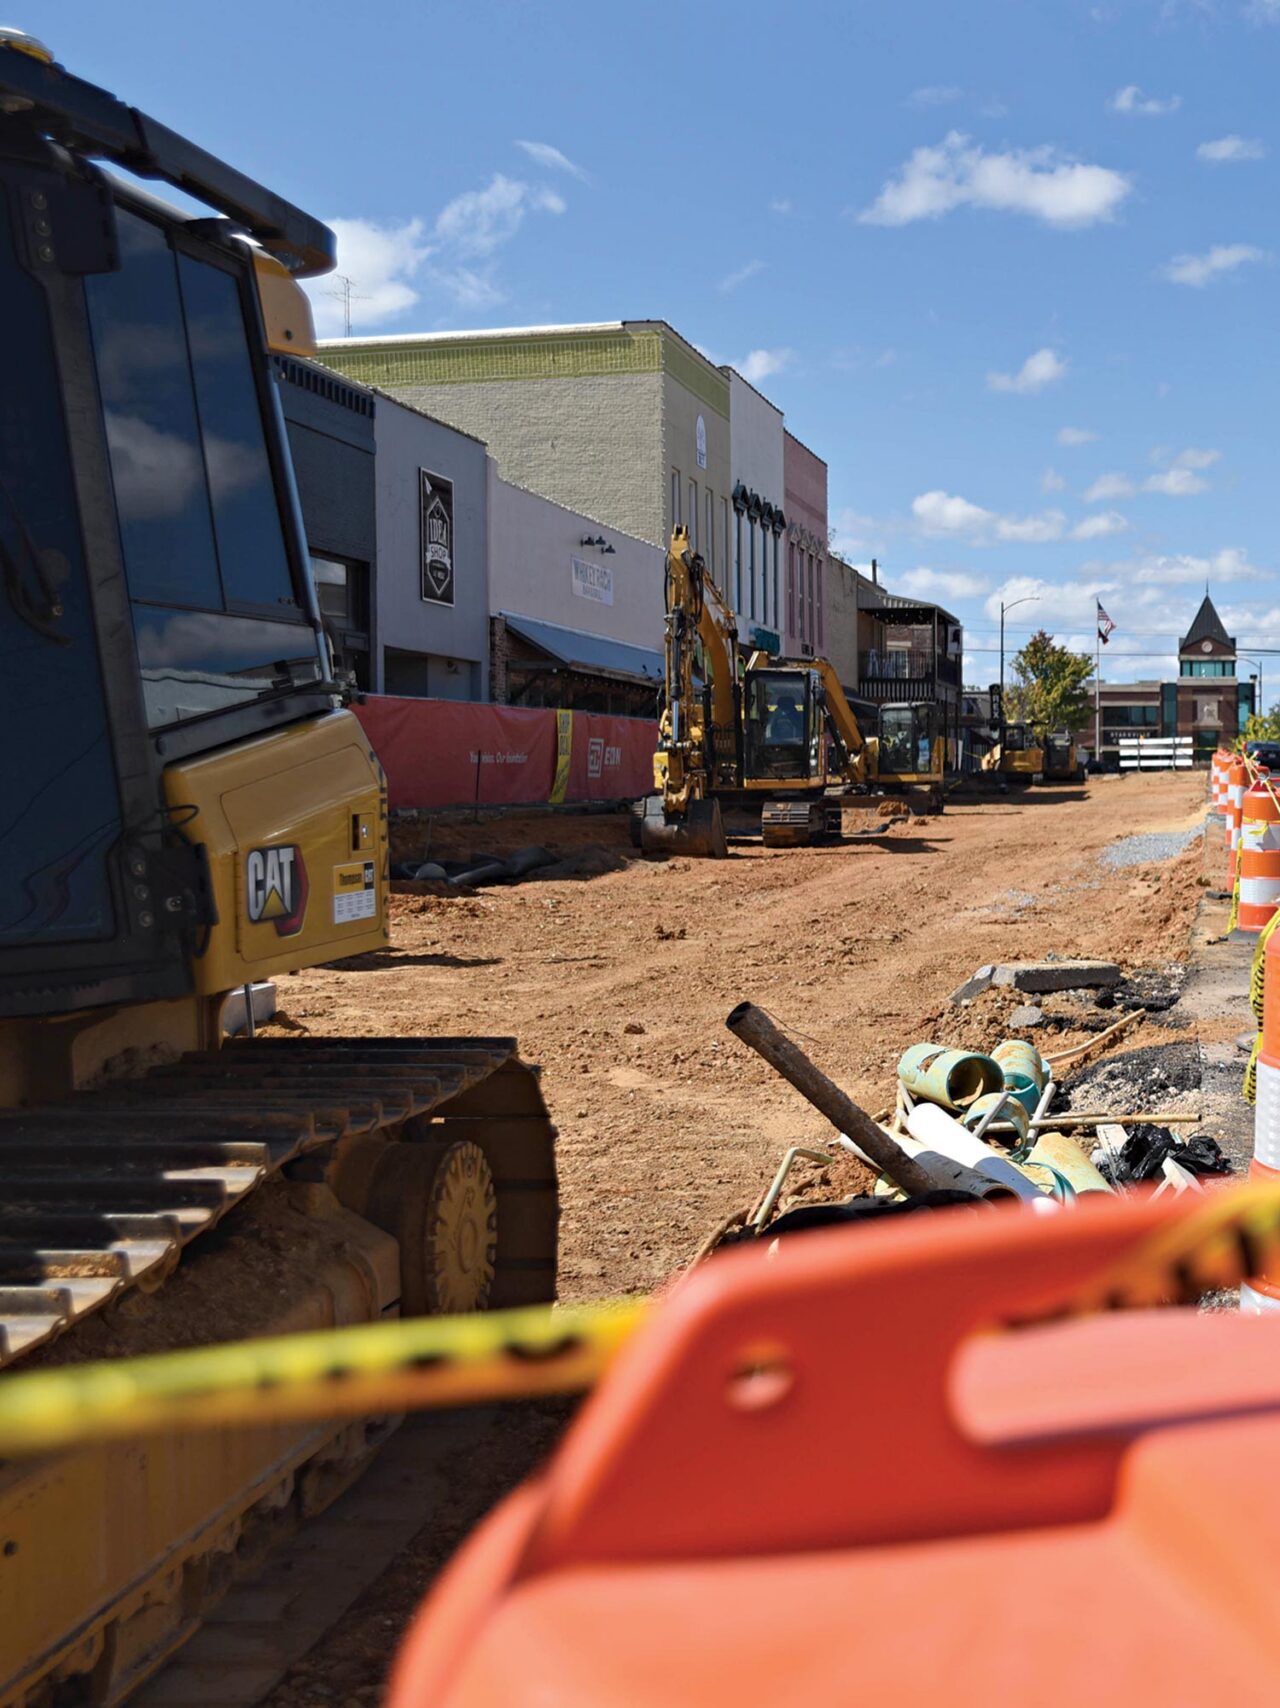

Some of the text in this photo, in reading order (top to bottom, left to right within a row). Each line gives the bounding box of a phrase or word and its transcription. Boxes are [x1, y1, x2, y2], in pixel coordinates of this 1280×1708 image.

[430, 518, 448, 546] IDEA
[430, 546, 448, 560] SHOP
[248, 847, 295, 920] CAT
